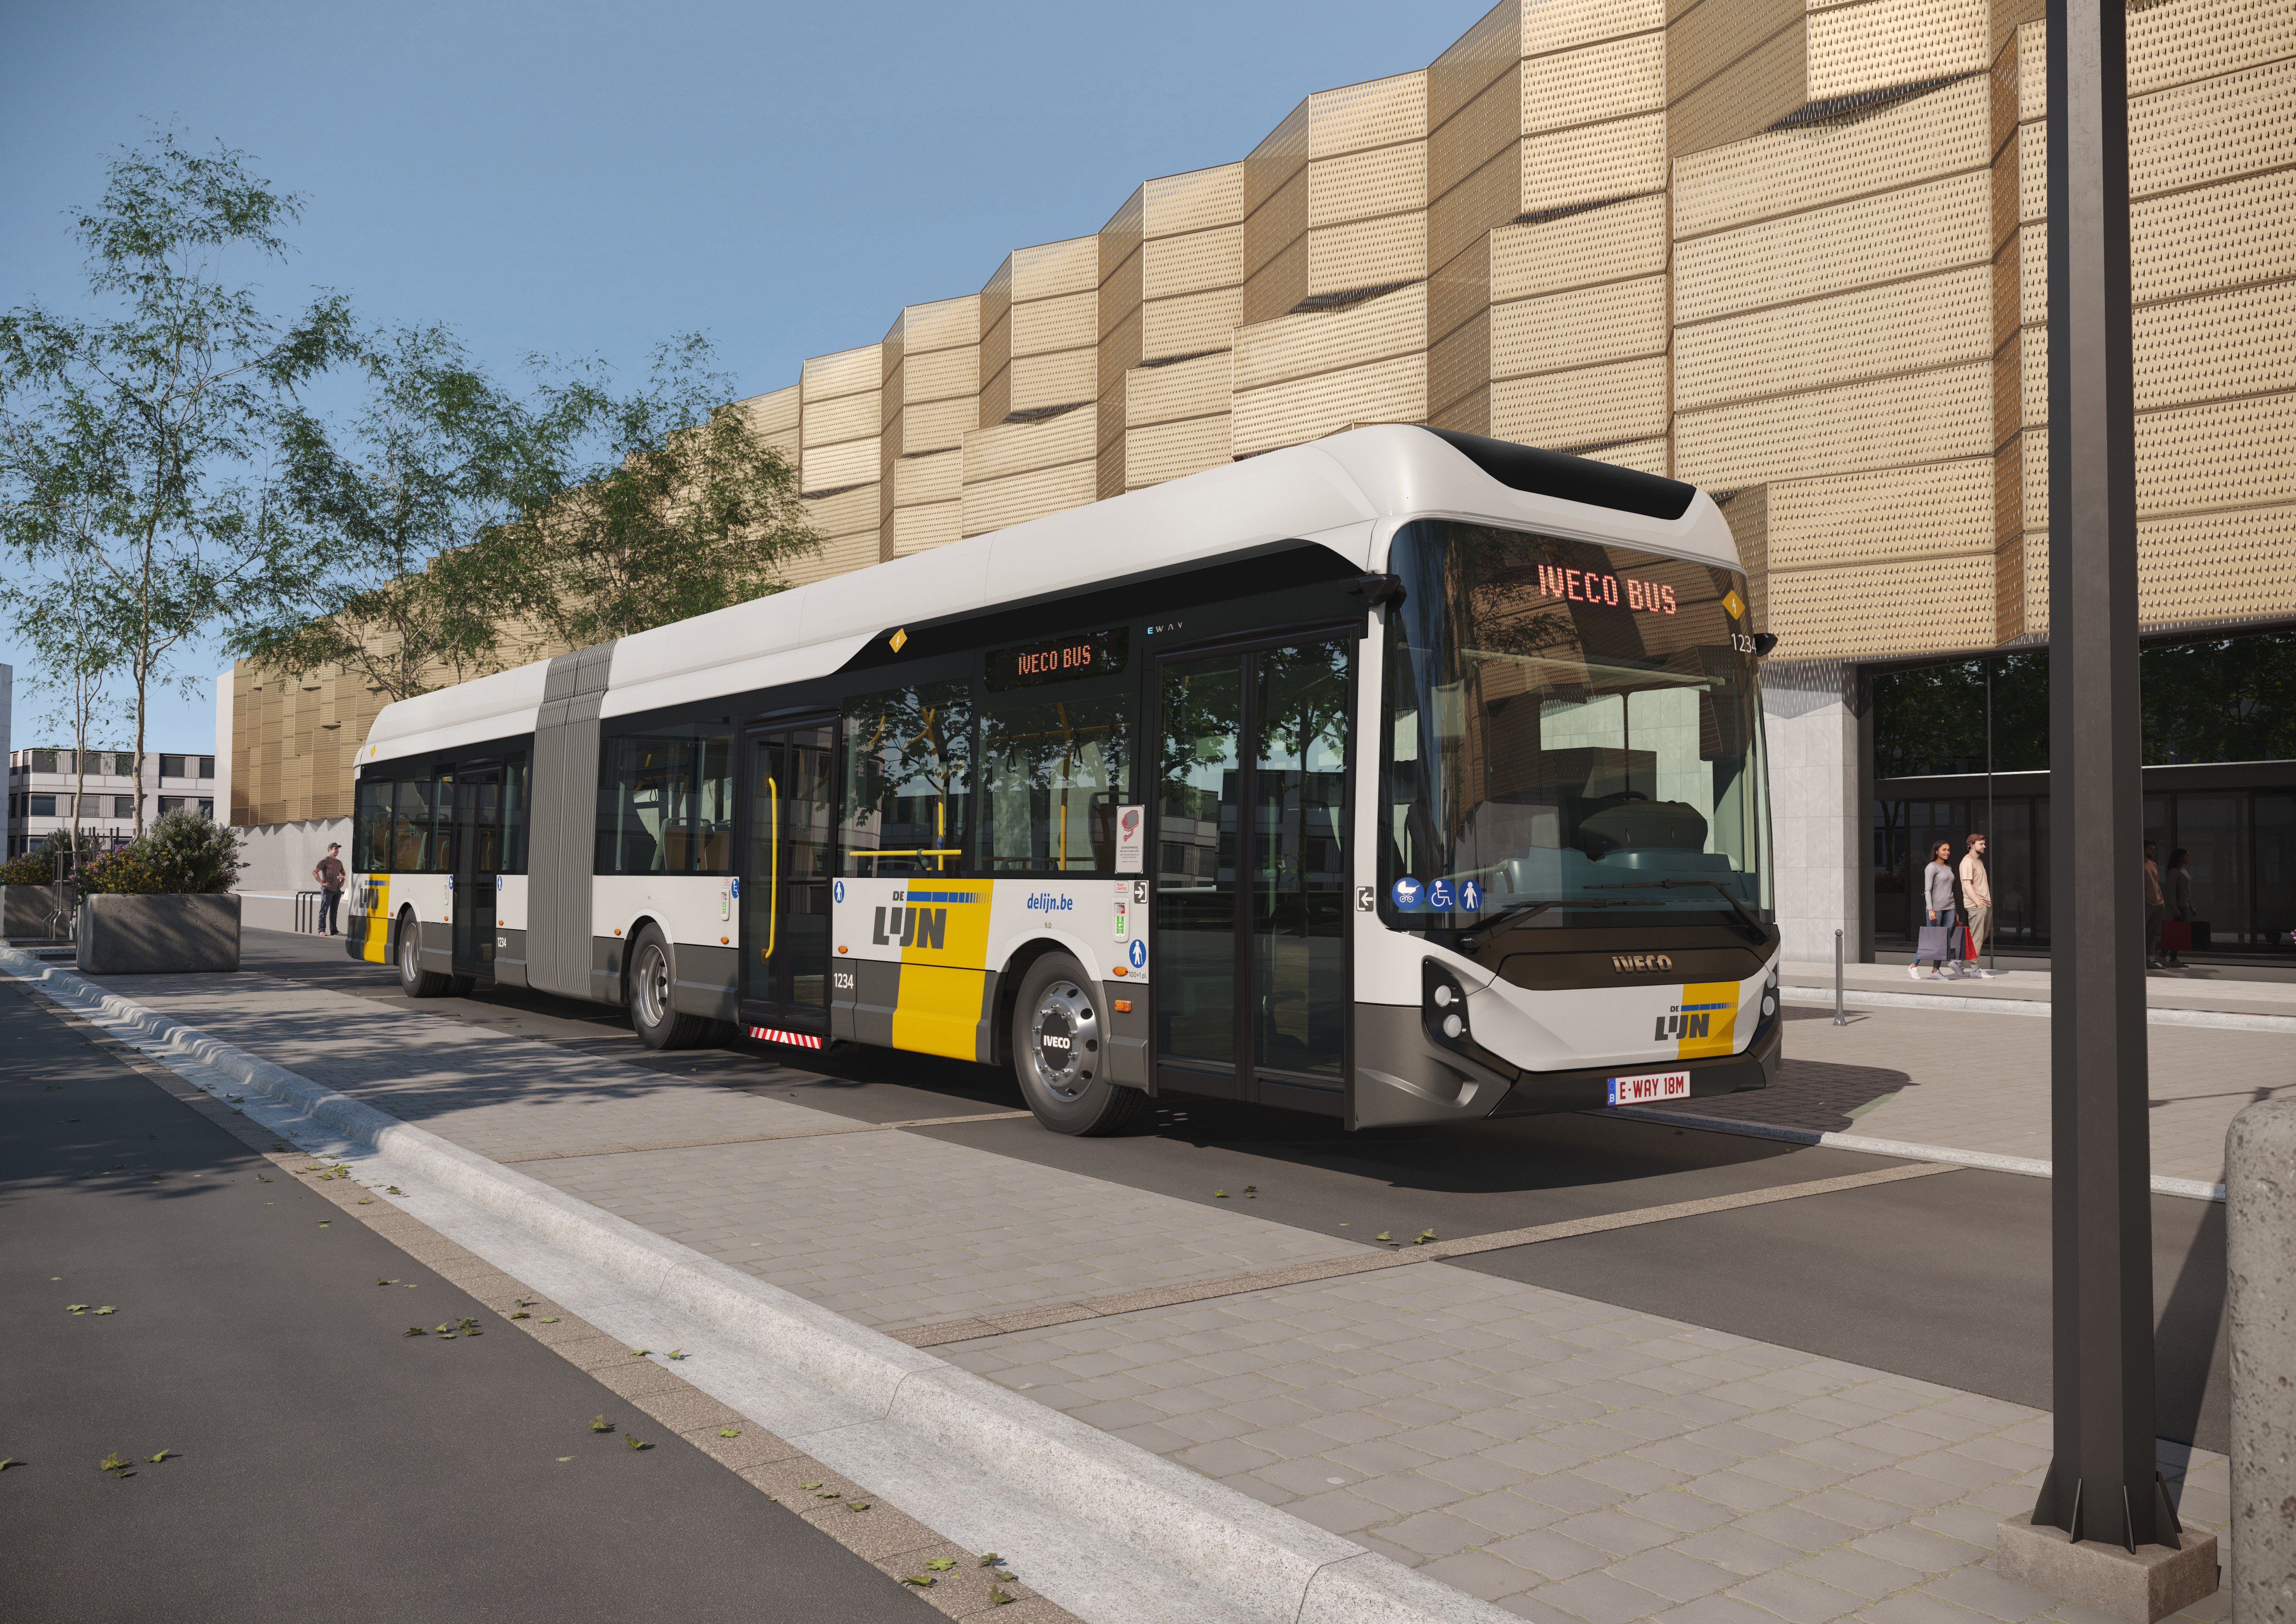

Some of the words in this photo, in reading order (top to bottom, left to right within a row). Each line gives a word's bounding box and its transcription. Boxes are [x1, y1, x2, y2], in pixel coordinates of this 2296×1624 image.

[1538, 564, 1618, 606] IVECO
[1627, 579, 1676, 615] BUS
[1731, 633, 1757, 655] 1234
[1019, 650, 1058, 675] IVECO
[1063, 644, 1090, 668] BUS
[359, 888, 379, 909] LIJN
[892, 891, 904, 901] DE
[1027, 893, 1073, 913] delijn.be
[872, 906, 947, 949] LIJN
[497, 937, 507, 947] 1234
[1612, 955, 1672, 974] IVECO
[834, 973, 854, 989] 1234
[1655, 1013, 1710, 1041] LIJN
[1043, 1035, 1070, 1049] IVECO
[1609, 1093, 1615, 1102] B
[1620, 1078, 1659, 1099] E-WAY
[1664, 1076, 1684, 1095] 18M
